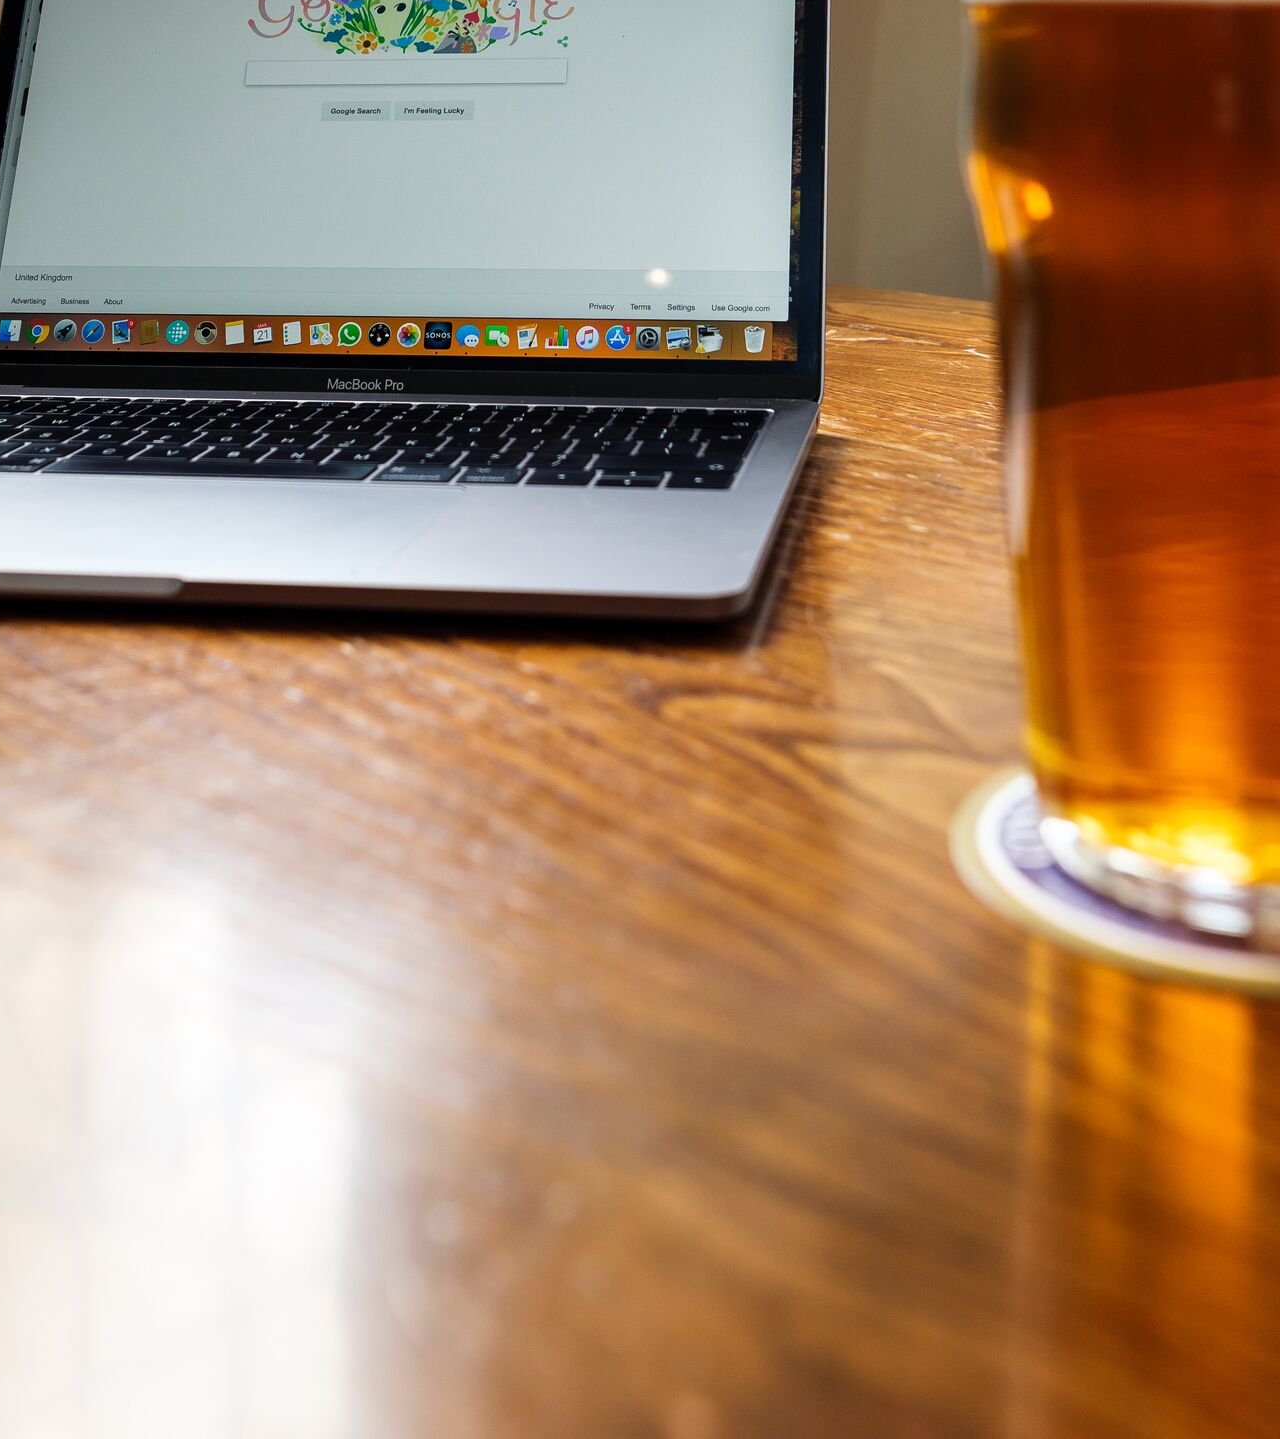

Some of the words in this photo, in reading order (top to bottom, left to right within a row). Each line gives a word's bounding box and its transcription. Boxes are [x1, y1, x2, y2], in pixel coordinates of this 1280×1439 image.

[330, 107, 355, 115] Google
[356, 107, 381, 115] Search
[416, 107, 442, 115] Feeling
[443, 107, 465, 115] Lucky
[15, 273, 39, 282] United
[40, 273, 73, 283] Kingdom
[10, 297, 47, 306] Advertising
[60, 297, 90, 305] Business
[103, 298, 123, 306] About
[588, 302, 615, 312] Privacy
[630, 303, 652, 311] Terms
[667, 303, 696, 313] Settings
[711, 304, 726, 312] Use
[727, 304, 771, 313] Google.com
[256, 330, 270, 341] 21
[425, 330, 451, 339] SONOS
[326, 378, 382, 391] MacBook
[384, 378, 405, 391] Pro
